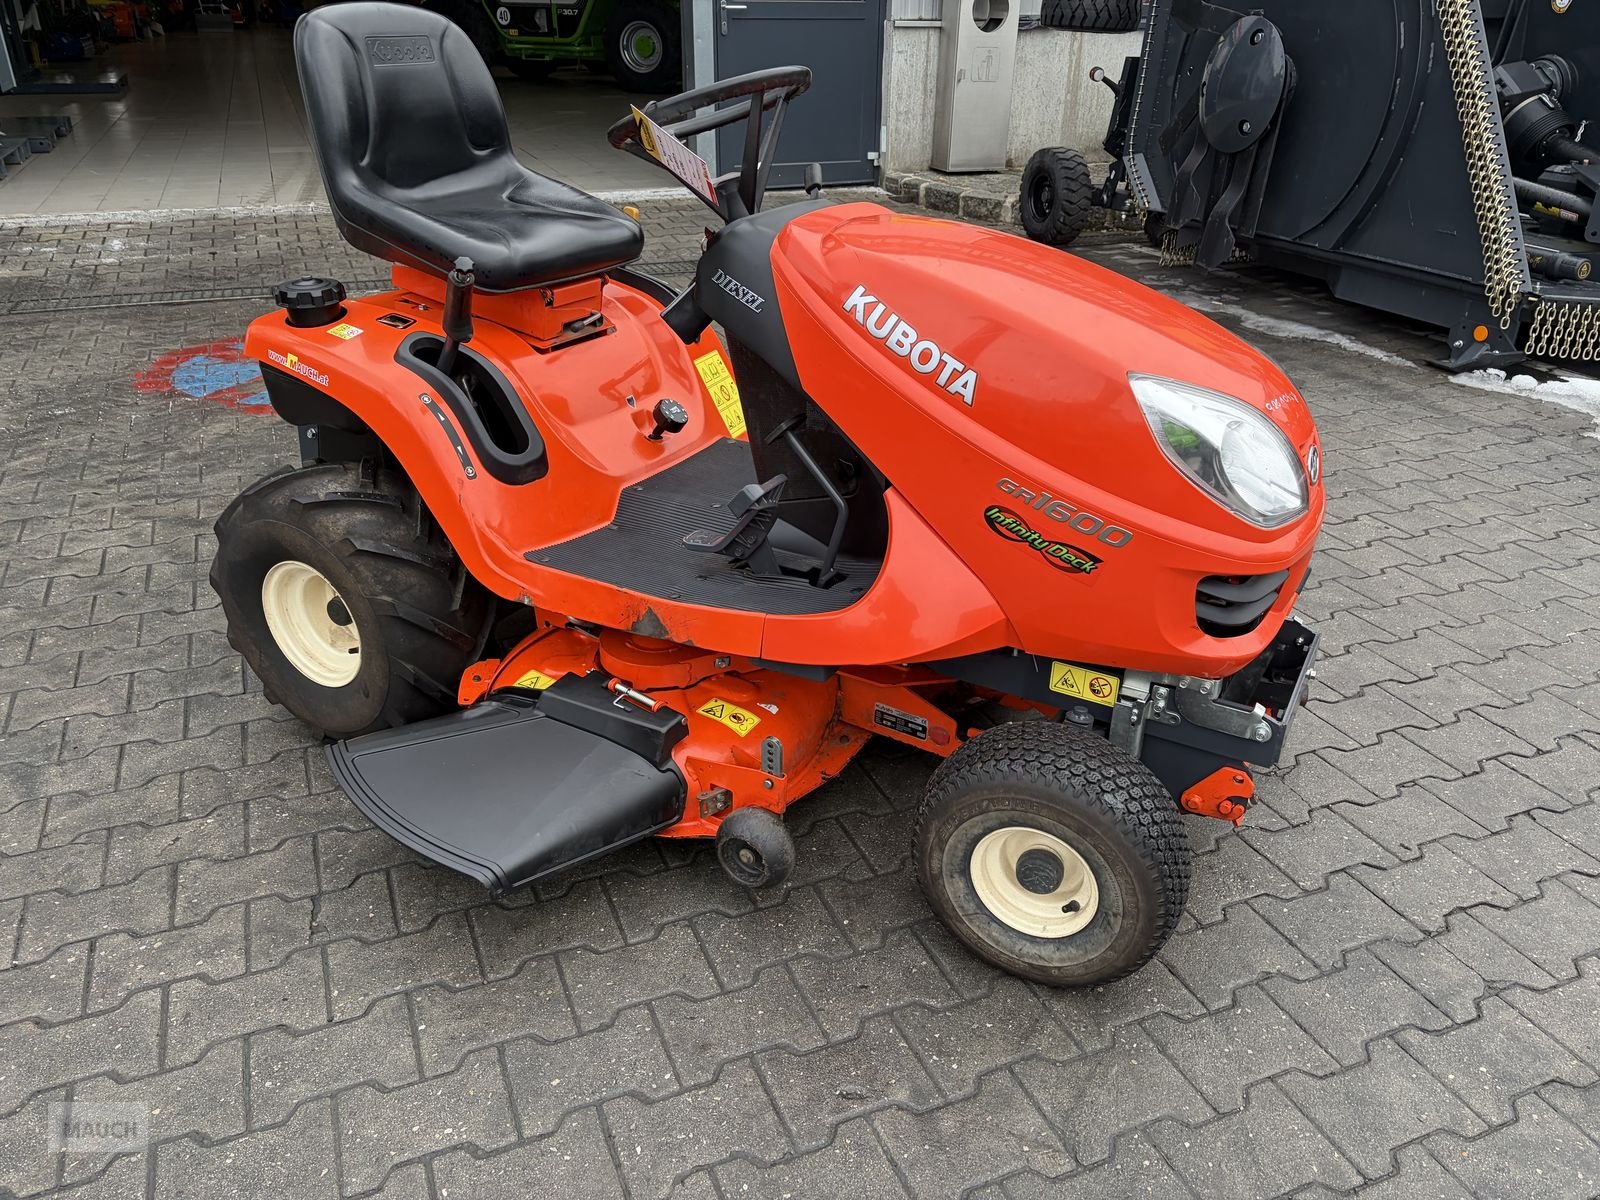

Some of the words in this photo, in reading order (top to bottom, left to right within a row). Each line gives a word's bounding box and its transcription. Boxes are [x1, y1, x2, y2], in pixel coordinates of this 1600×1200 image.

[498, 9, 508, 21] 40
[711, 268, 766, 314] DIESEL
[268, 350, 329, 386] www.MAUCH.at
[842, 284, 978, 407] KUBOTA
[985, 507, 1050, 550] Infinity
[1047, 543, 1098, 574] Deck
[996, 477, 1134, 548] GR1600
